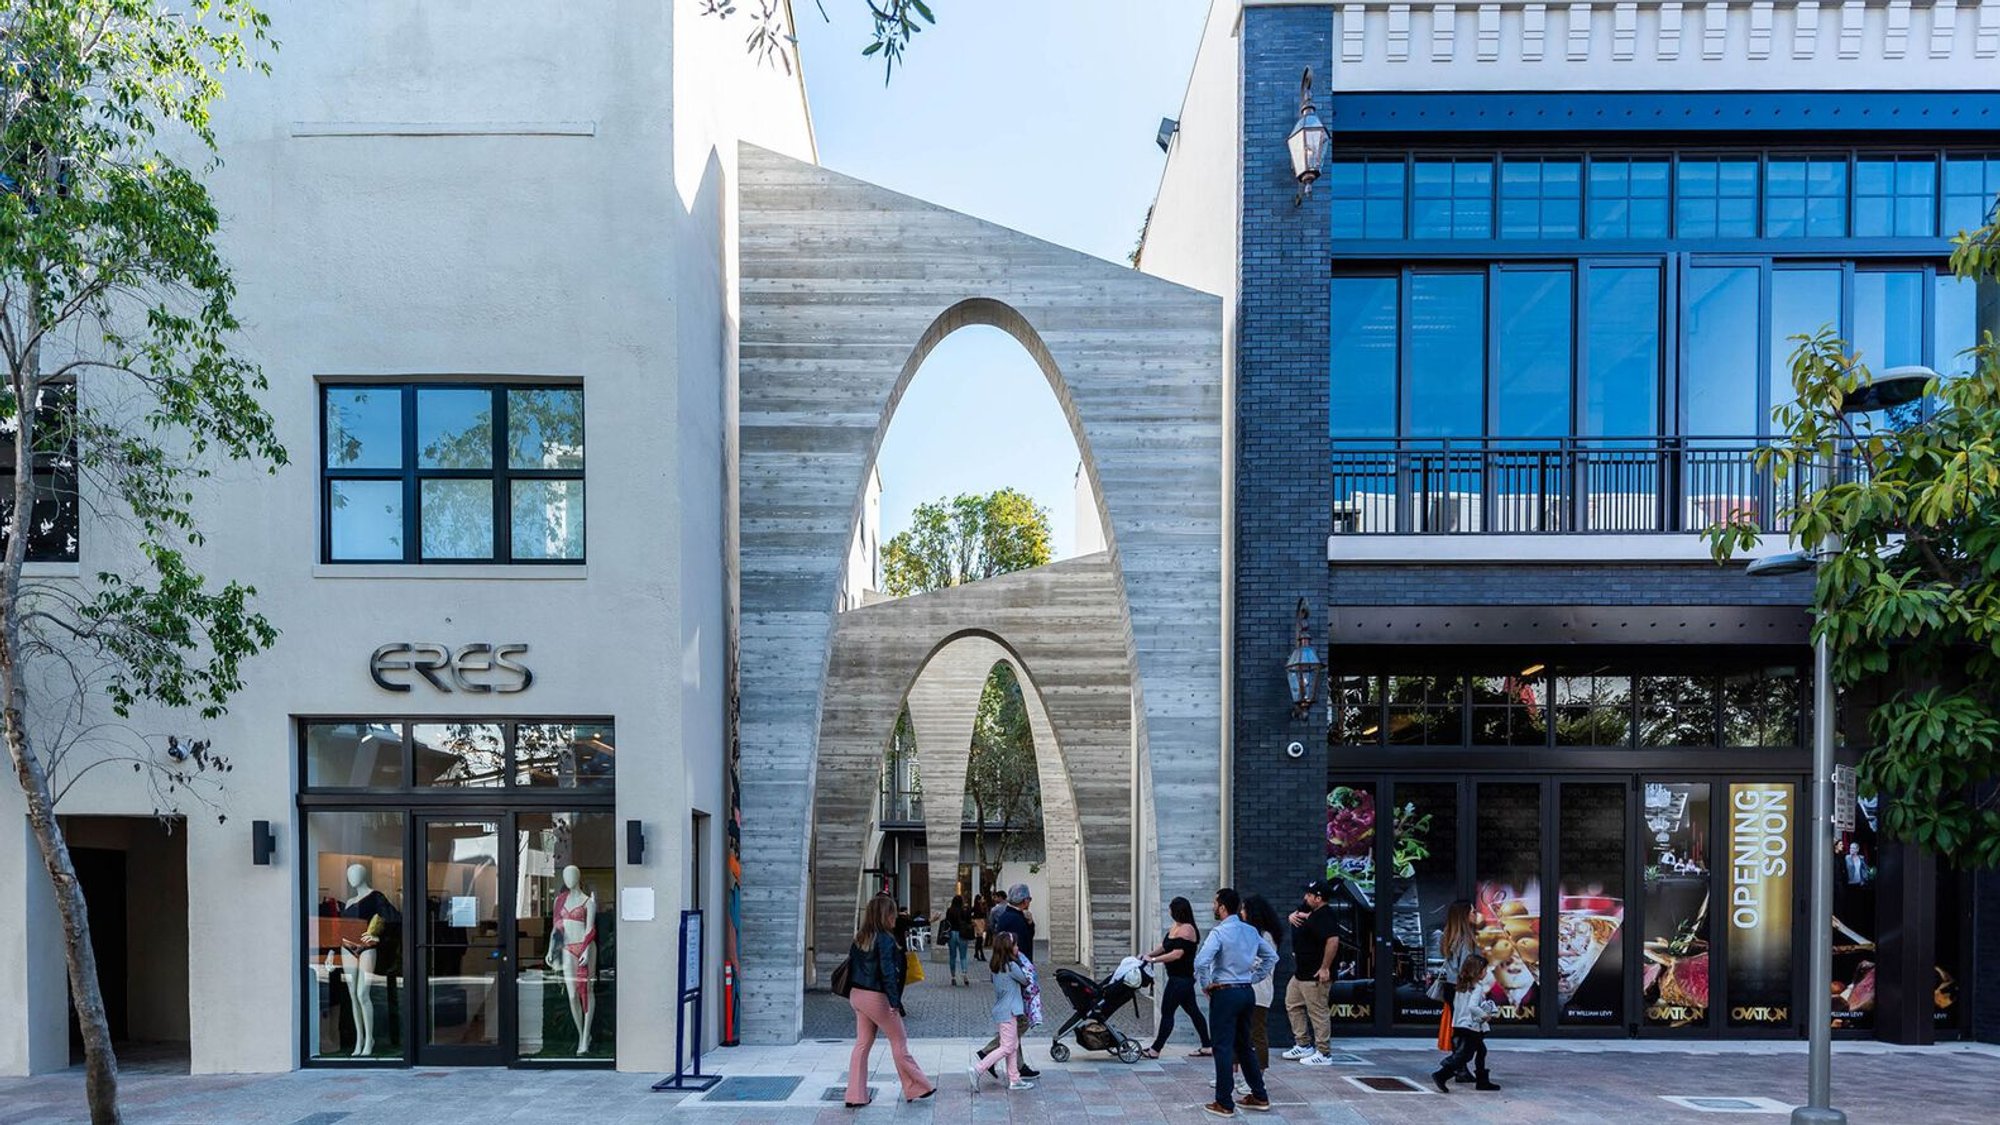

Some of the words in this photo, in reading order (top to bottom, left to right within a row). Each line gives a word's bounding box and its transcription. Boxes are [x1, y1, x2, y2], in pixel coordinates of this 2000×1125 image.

[370, 642, 533, 693] ERES
[1761, 790, 1788, 877] SOON
[1733, 790, 1760, 929] OPENING
[1648, 1006, 1704, 1021] OVATION
[1731, 1006, 1787, 1022] OVATION
